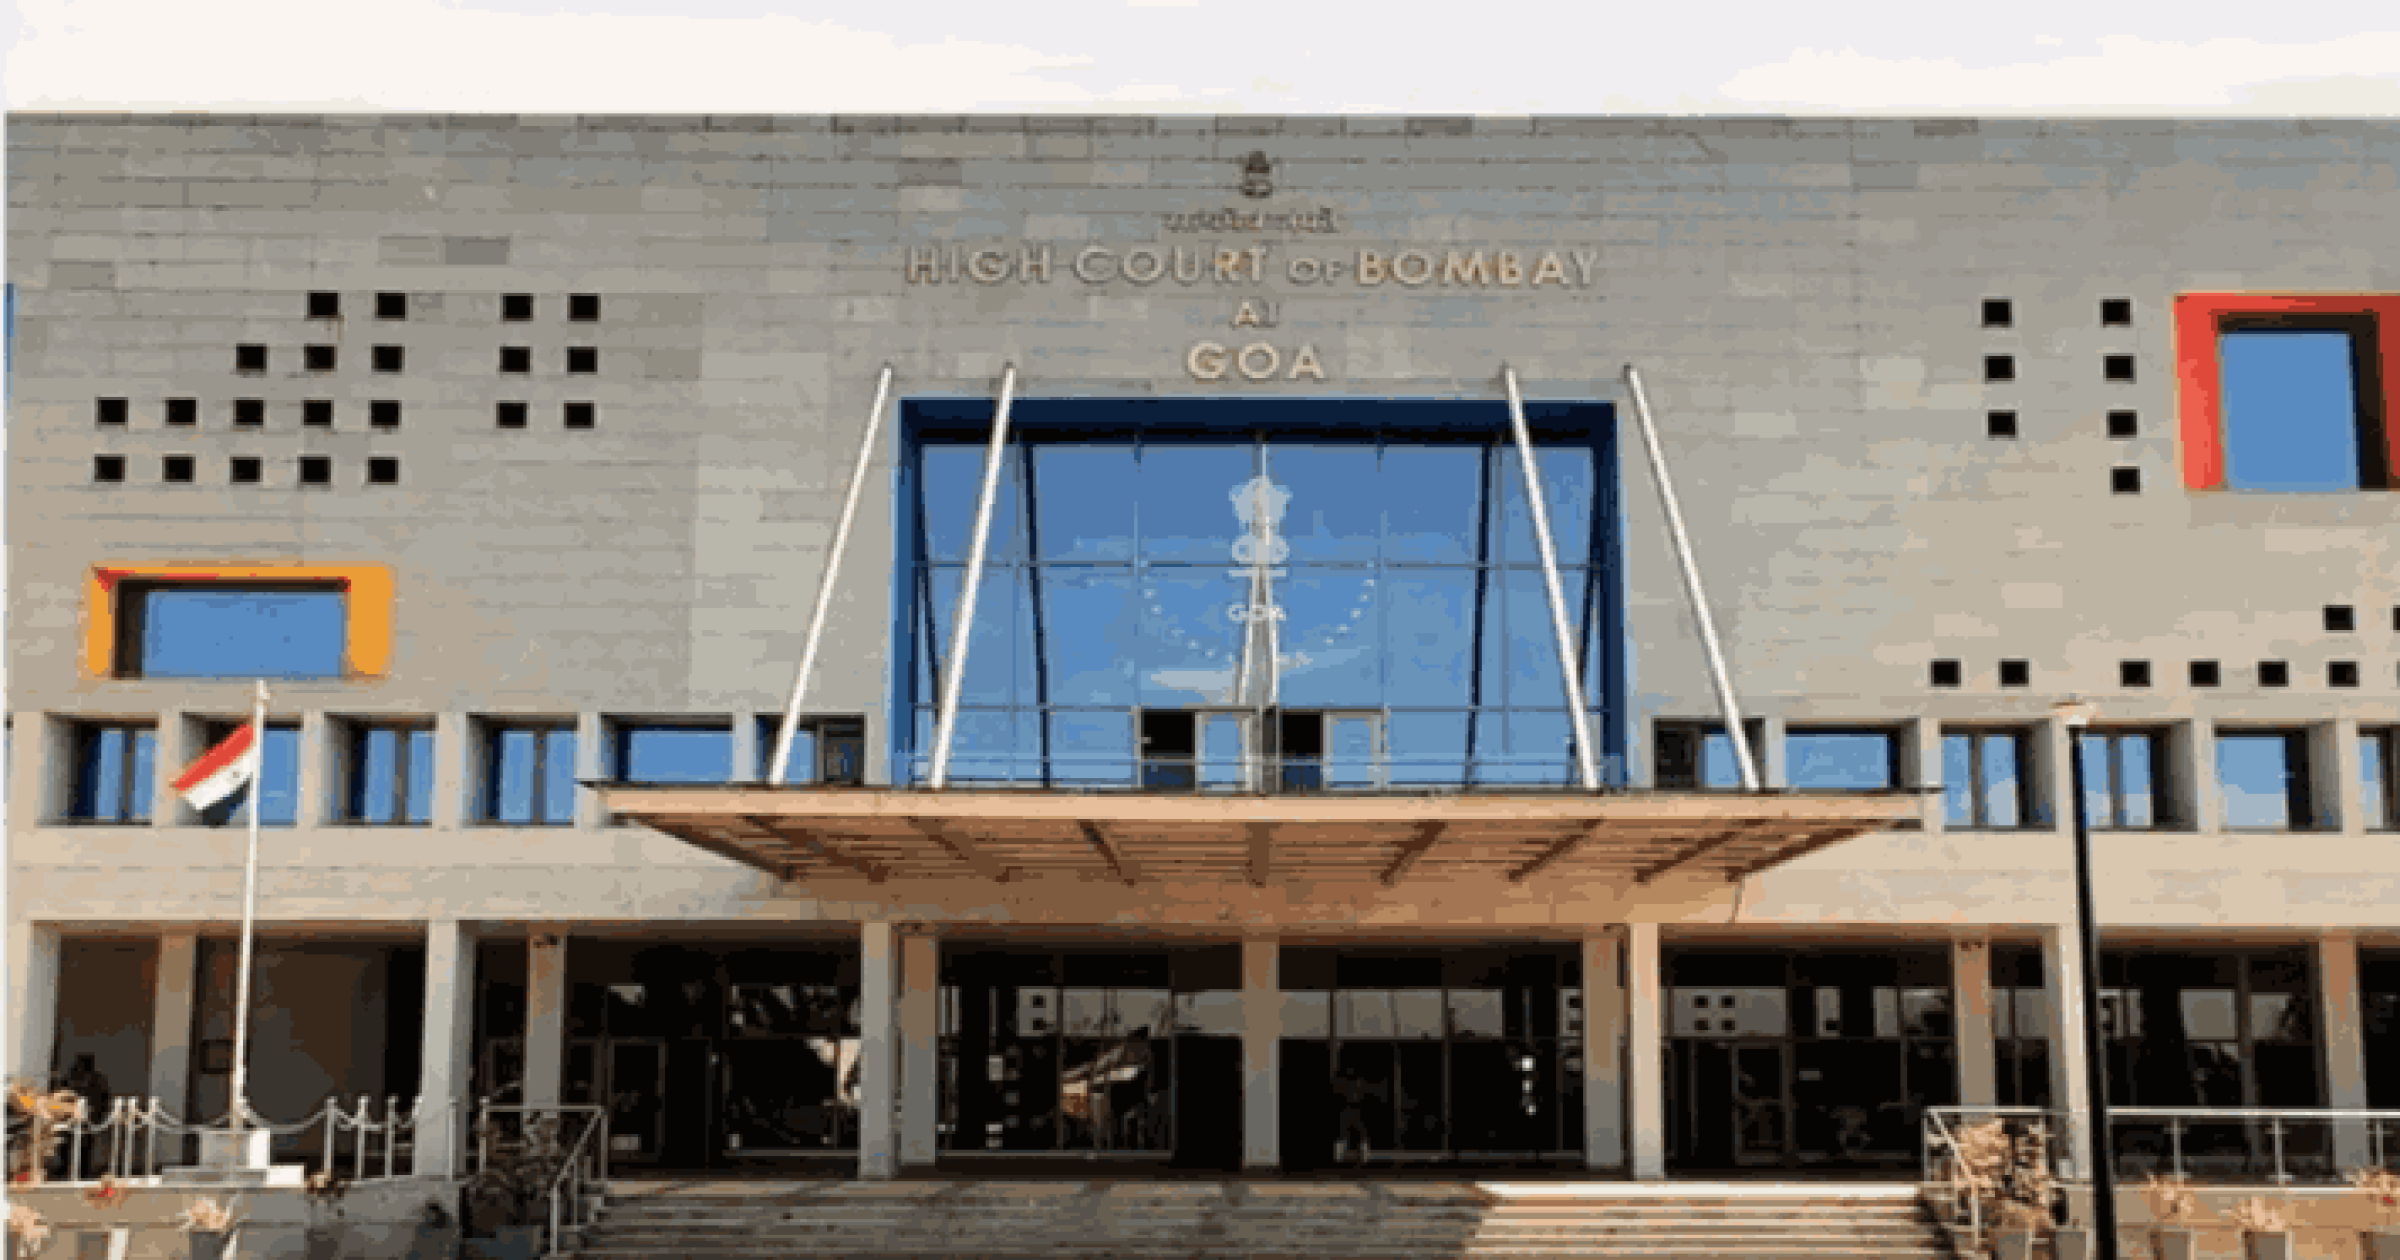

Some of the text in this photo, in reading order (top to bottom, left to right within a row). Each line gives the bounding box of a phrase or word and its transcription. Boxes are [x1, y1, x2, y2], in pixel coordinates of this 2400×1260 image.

[904, 246, 1599, 287] HIGH COURT OF BOMBAY
[1188, 339, 1325, 380] GOA
